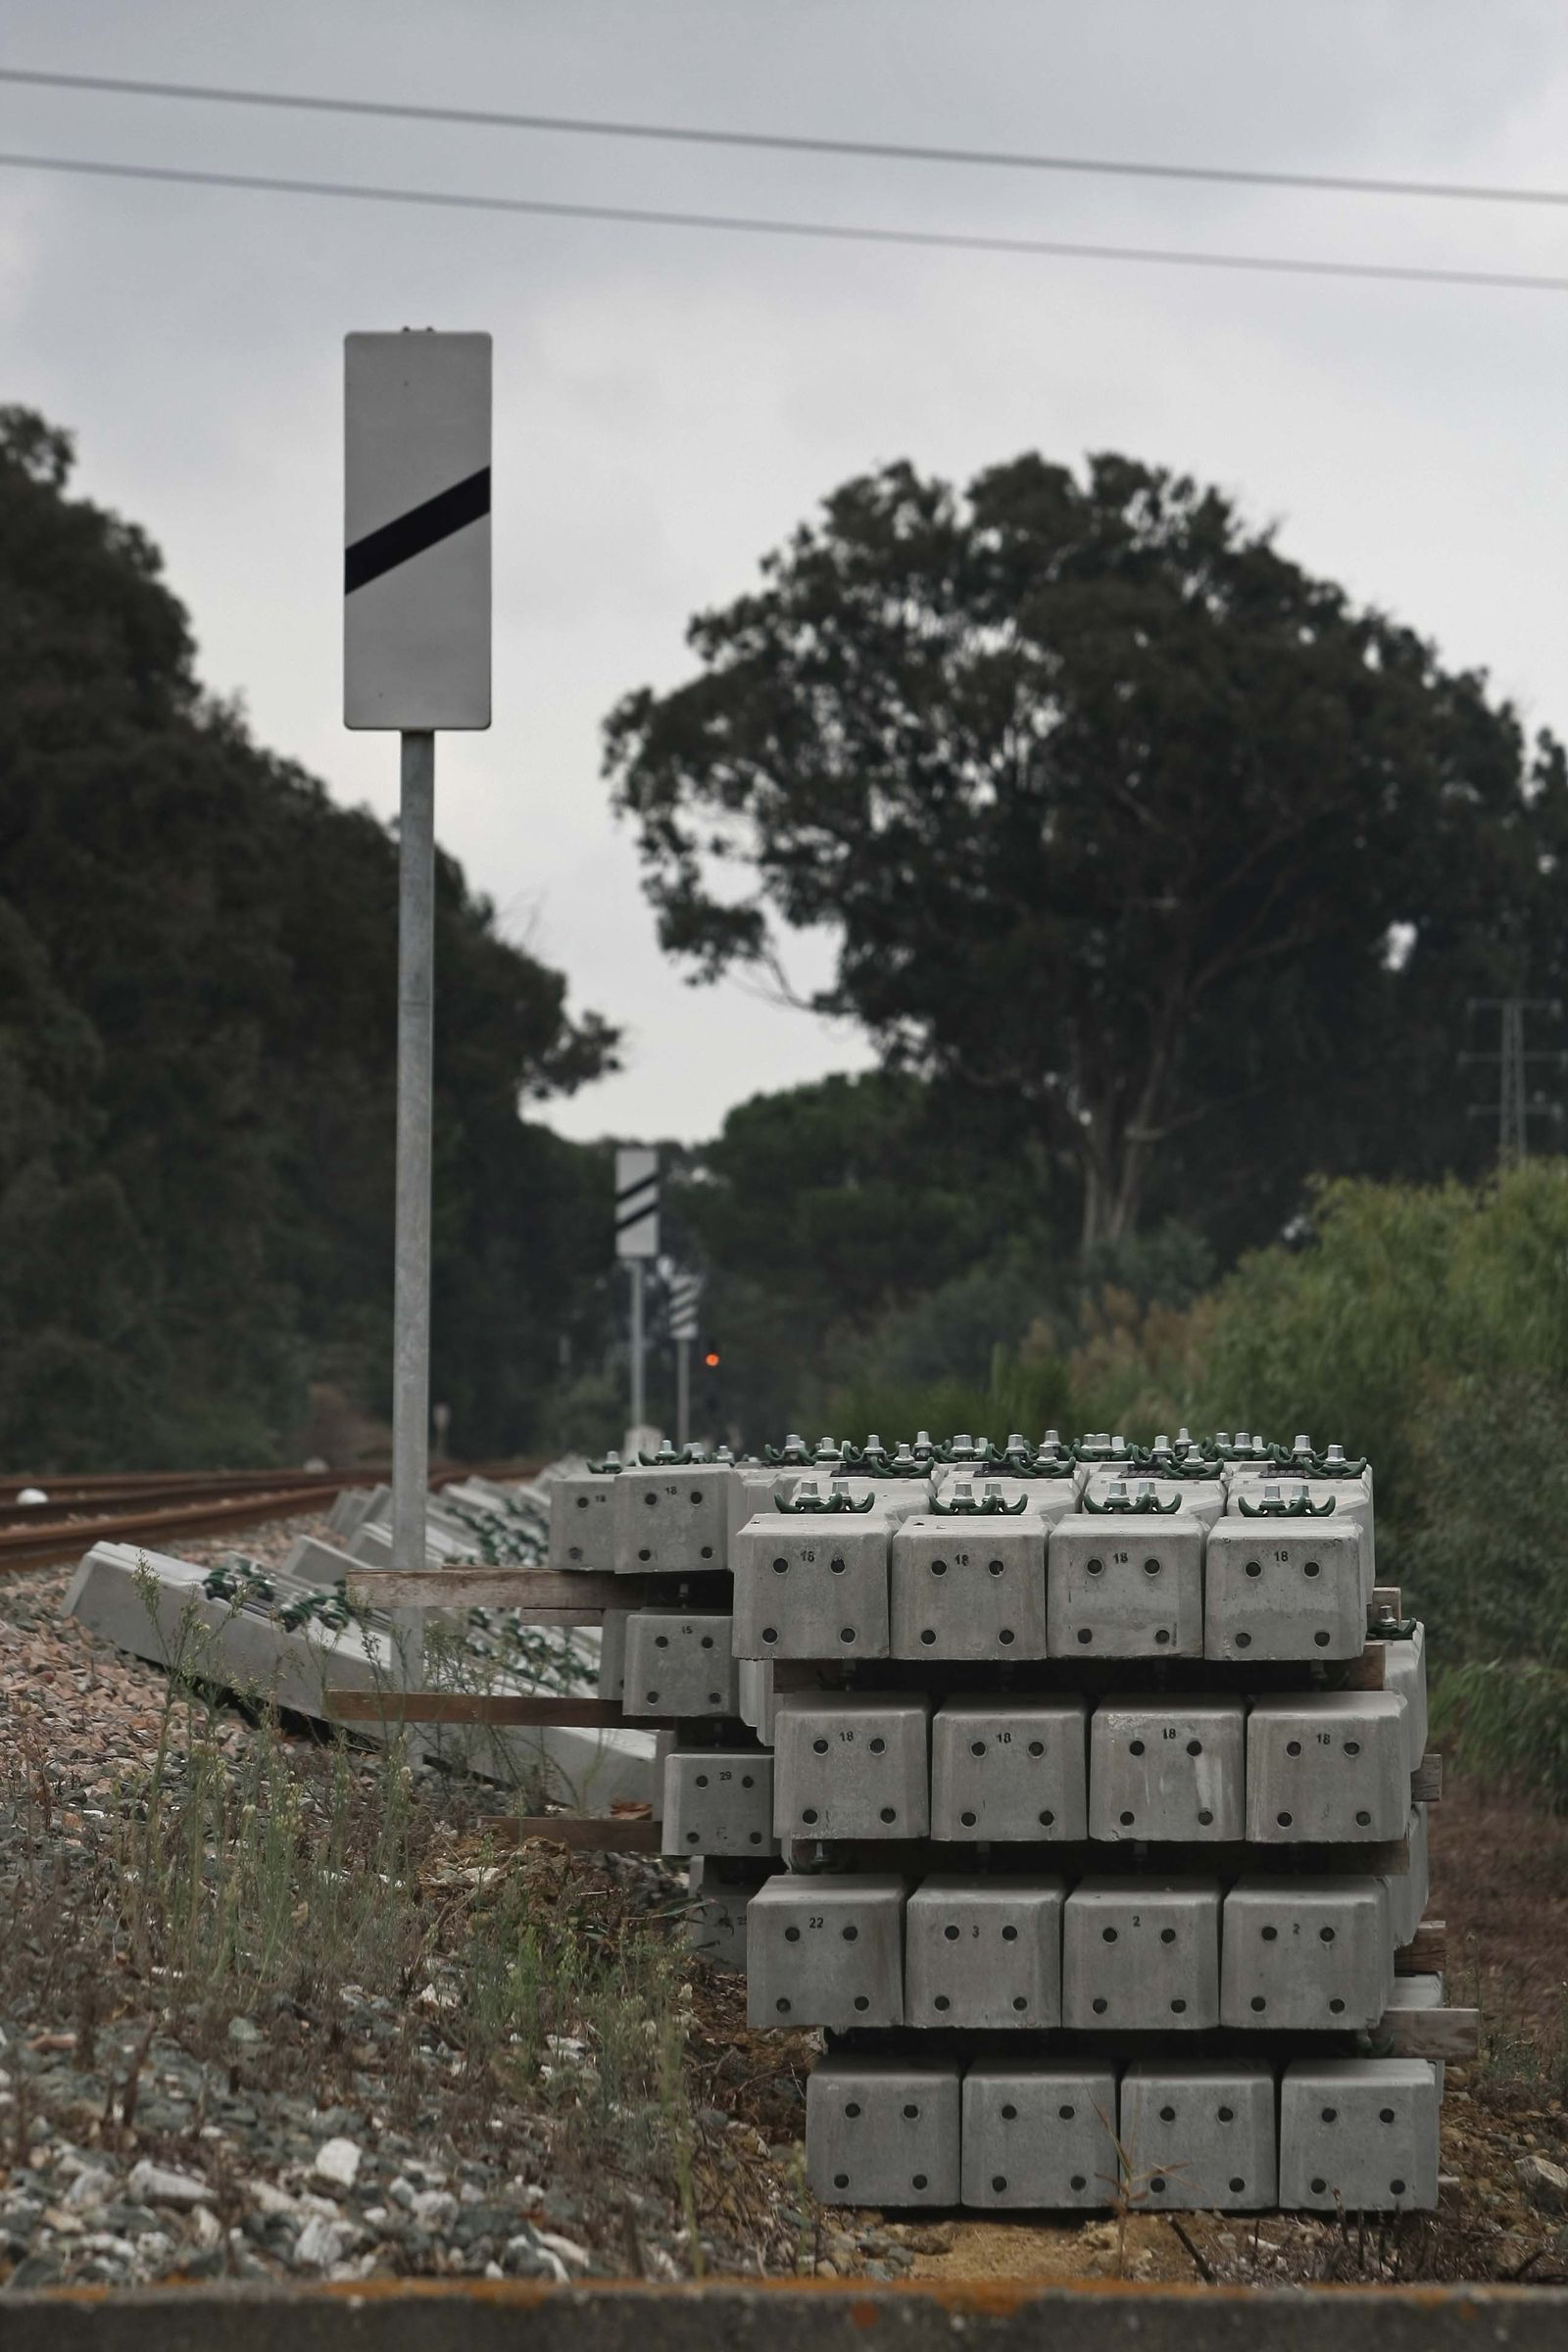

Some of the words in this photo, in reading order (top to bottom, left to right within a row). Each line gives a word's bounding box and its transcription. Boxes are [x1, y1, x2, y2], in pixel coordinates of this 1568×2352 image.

[664, 1486, 677, 1495] 18
[800, 1550, 815, 1563] 18
[955, 1553, 969, 1567] 18
[1113, 1552, 1128, 1564] 18
[1274, 1550, 1289, 1562] 18
[839, 1731, 854, 1742] 18
[996, 1733, 1011, 1744] 18
[1162, 1728, 1177, 1740] 18
[1316, 1733, 1331, 1744] 18
[719, 1771, 732, 1781] 29
[809, 1917, 824, 1929] 22
[1133, 1916, 1141, 1927] 2
[972, 1925, 980, 1938] 3
[1293, 1923, 1300, 1935] 2
